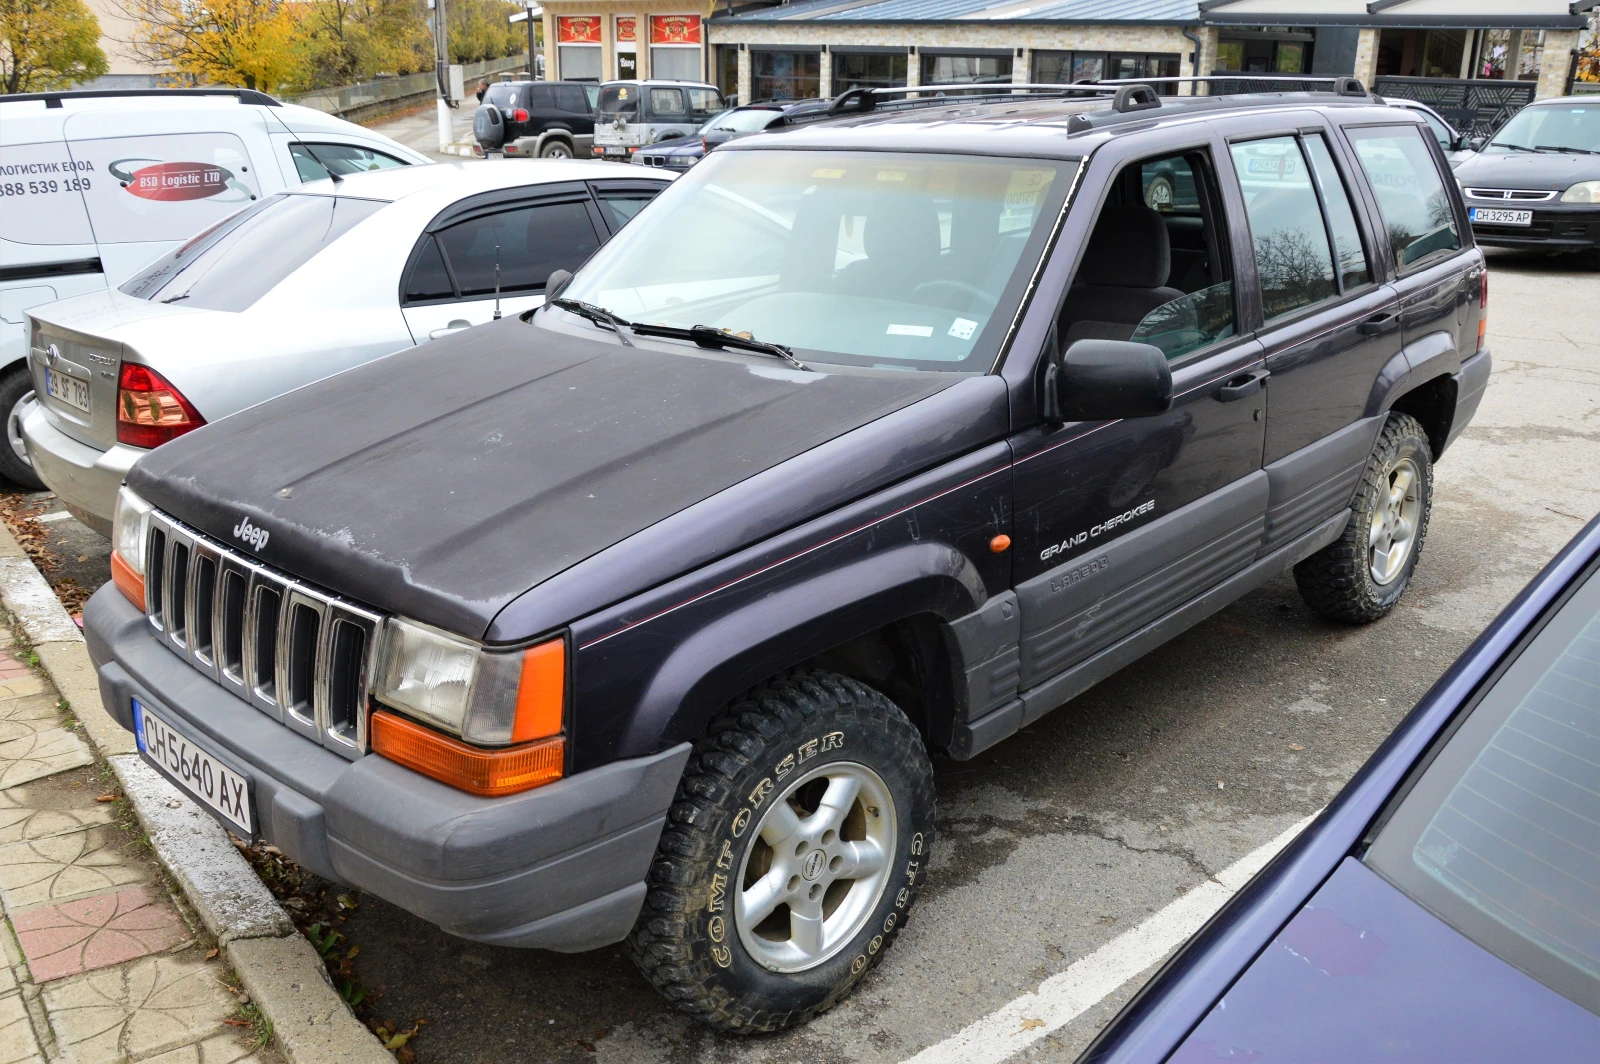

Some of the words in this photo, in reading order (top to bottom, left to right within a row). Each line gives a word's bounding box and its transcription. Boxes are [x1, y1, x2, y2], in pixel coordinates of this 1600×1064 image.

[62, 160, 95, 172] ЕООД
[140, 176, 158, 188] BSD
[161, 172, 200, 187] Logistic
[204, 171, 220, 182] LTD
[29, 180, 58, 194] 539
[63, 177, 91, 192] 189
[1515, 212, 1530, 222] AP
[61, 377, 70, 400] SF
[233, 516, 270, 552] Jeep
[1040, 531, 1088, 561] GRAND
[1090, 499, 1156, 538] CHEROKEE
[1051, 555, 1109, 593] LAREDO
[220, 770, 247, 824] AX
[708, 731, 845, 968] COMFORSER
[851, 832, 924, 975] CF3000
